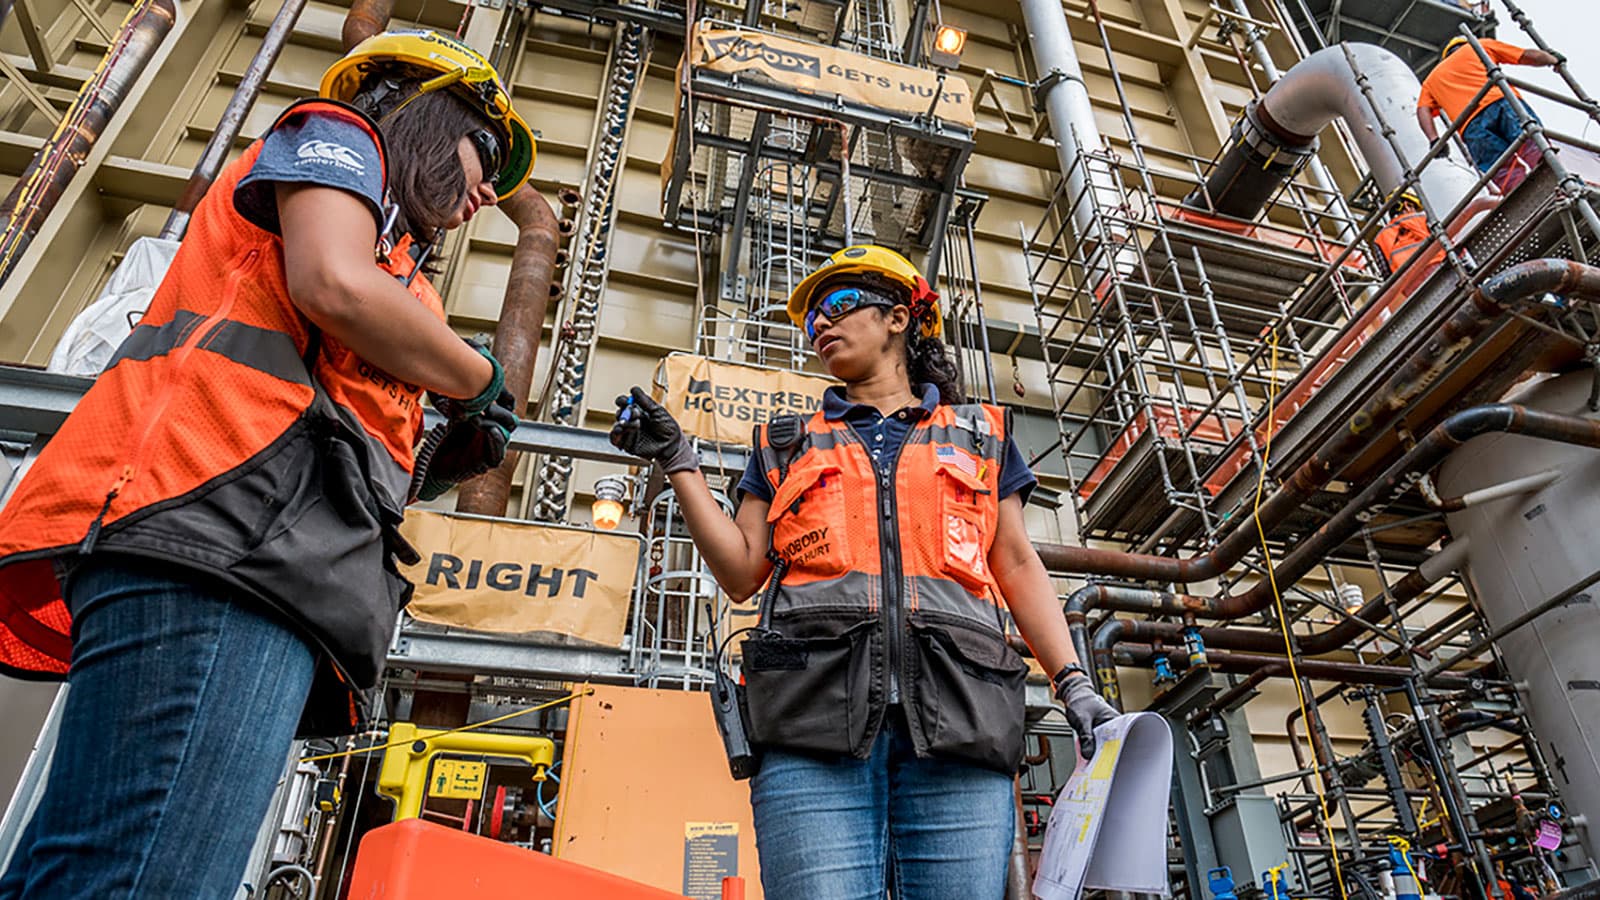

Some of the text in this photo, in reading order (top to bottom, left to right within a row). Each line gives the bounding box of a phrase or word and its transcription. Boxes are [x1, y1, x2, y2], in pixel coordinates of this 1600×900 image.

[825, 63, 891, 89] GETS
[357, 362, 399, 399] GETS
[782, 527, 829, 559] NOBODY
[426, 552, 598, 599] RIGHT
